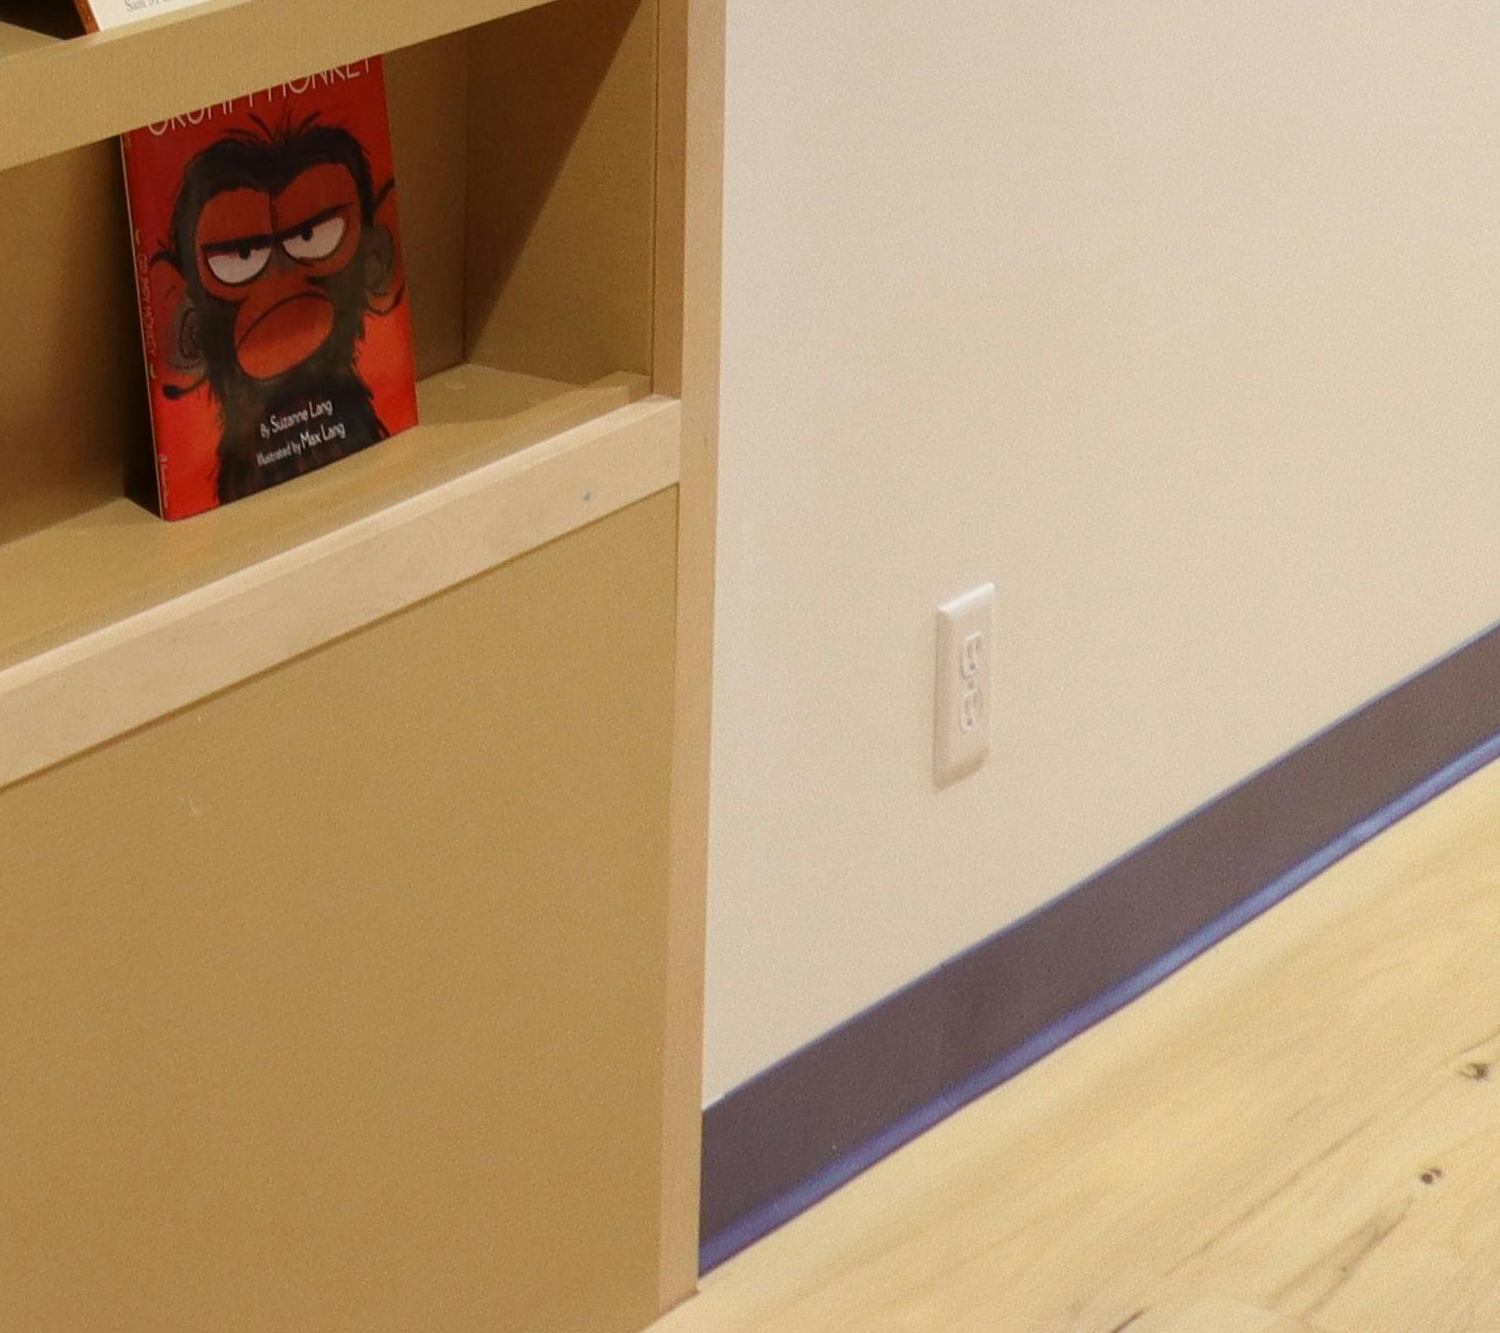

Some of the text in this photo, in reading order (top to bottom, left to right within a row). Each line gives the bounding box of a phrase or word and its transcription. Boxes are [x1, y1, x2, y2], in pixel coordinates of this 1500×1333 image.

[269, 398, 334, 435] Suzanne Lang
[300, 421, 347, 451] Max Lang
